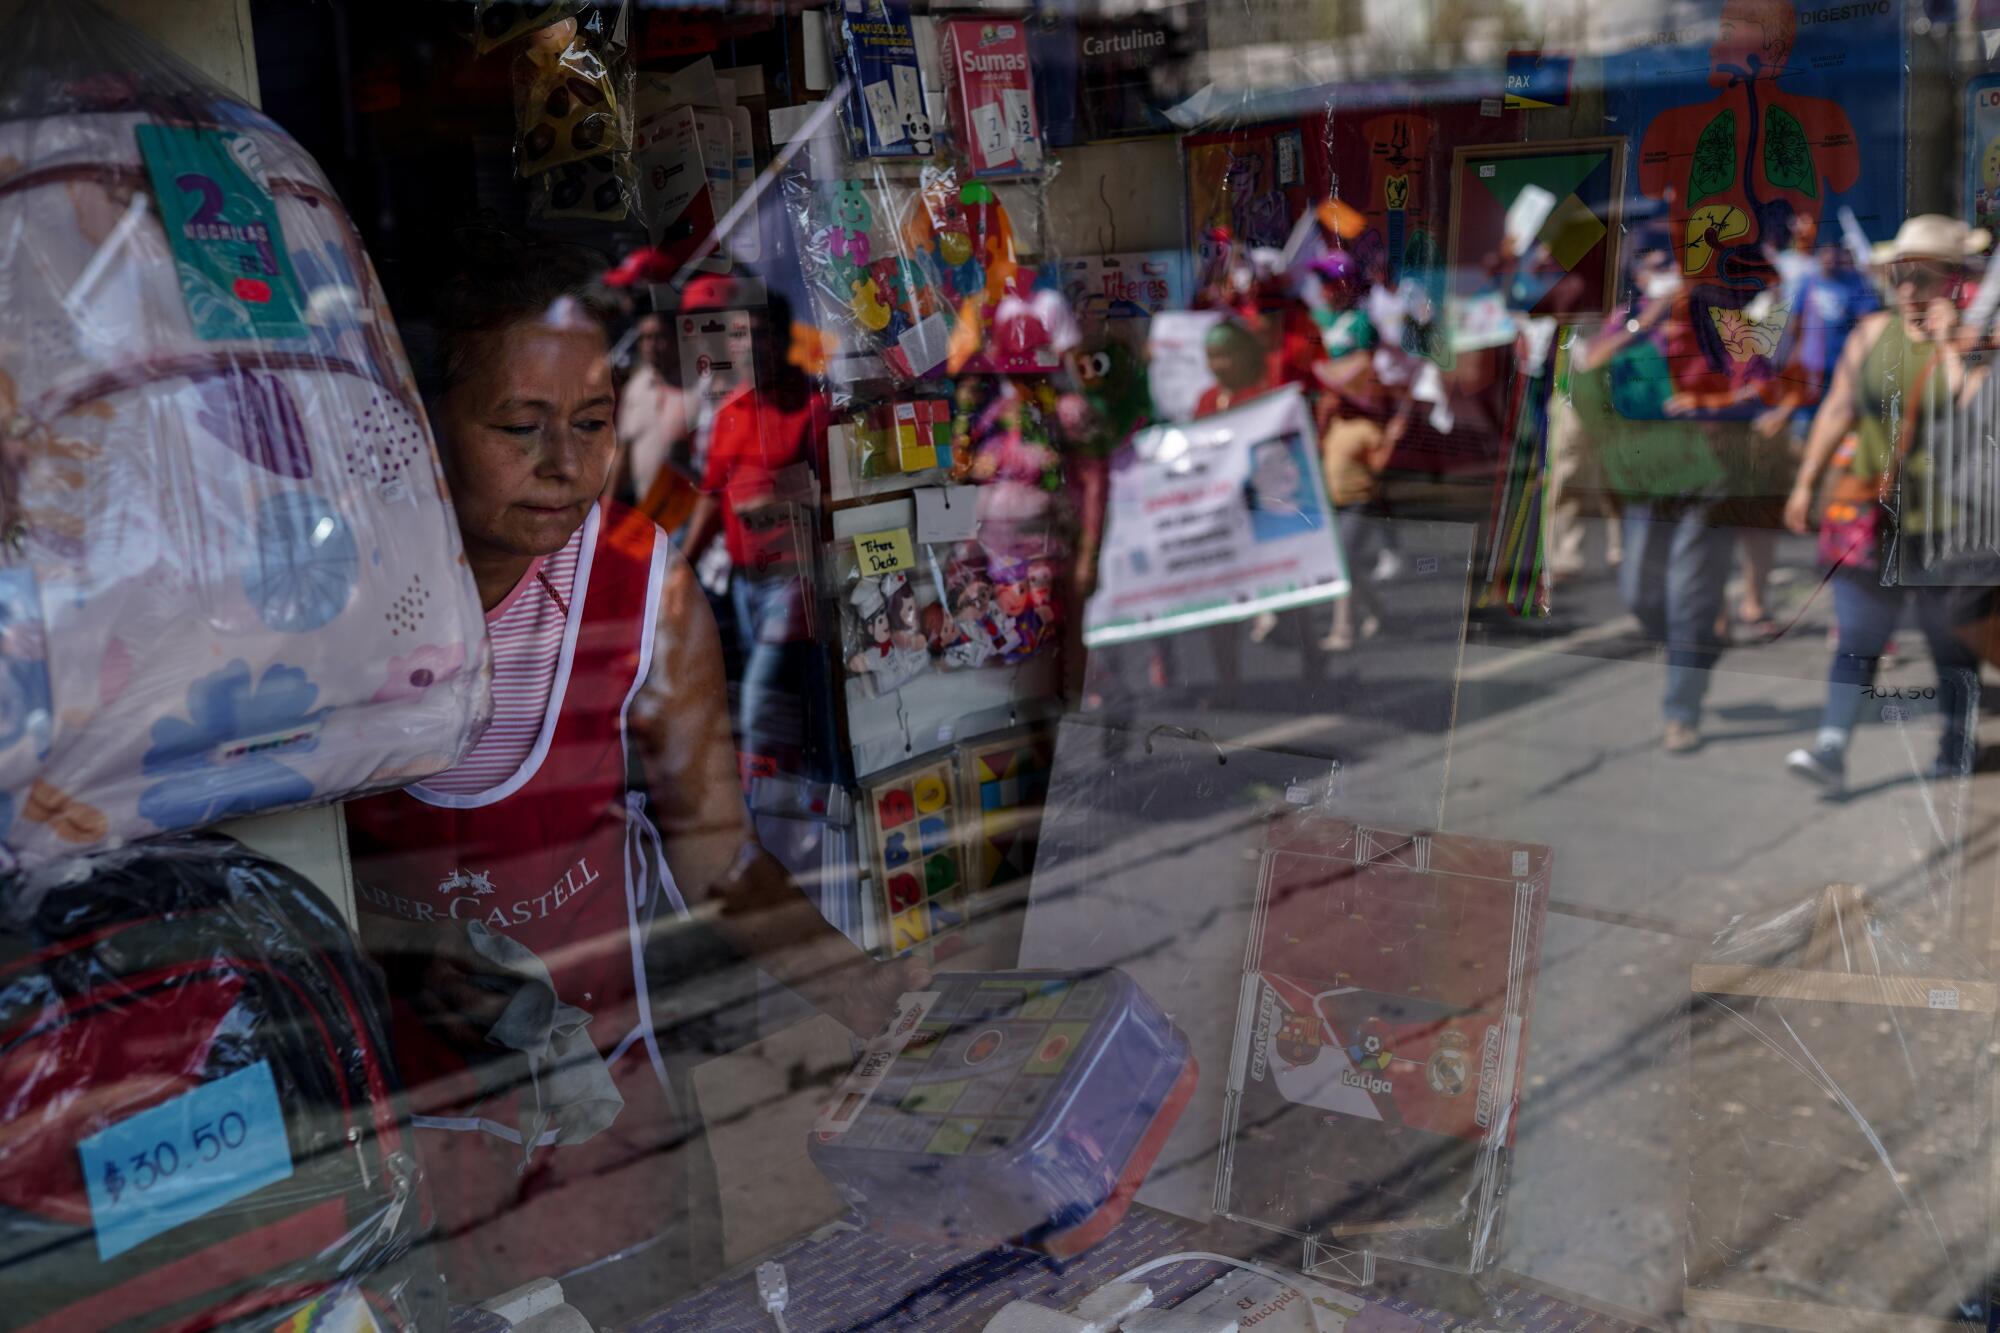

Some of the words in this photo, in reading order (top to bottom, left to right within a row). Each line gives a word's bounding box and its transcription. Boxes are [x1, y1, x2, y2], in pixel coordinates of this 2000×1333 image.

[1801, 1, 1890, 25] DIGESTIVO
[1083, 28, 1165, 56] Cartulina
[963, 51, 1026, 72] Sumas
[175, 172, 224, 225] 2
[1342, 1070, 1393, 1095] LaLiga
[102, 1110, 248, 1204] $30.50
